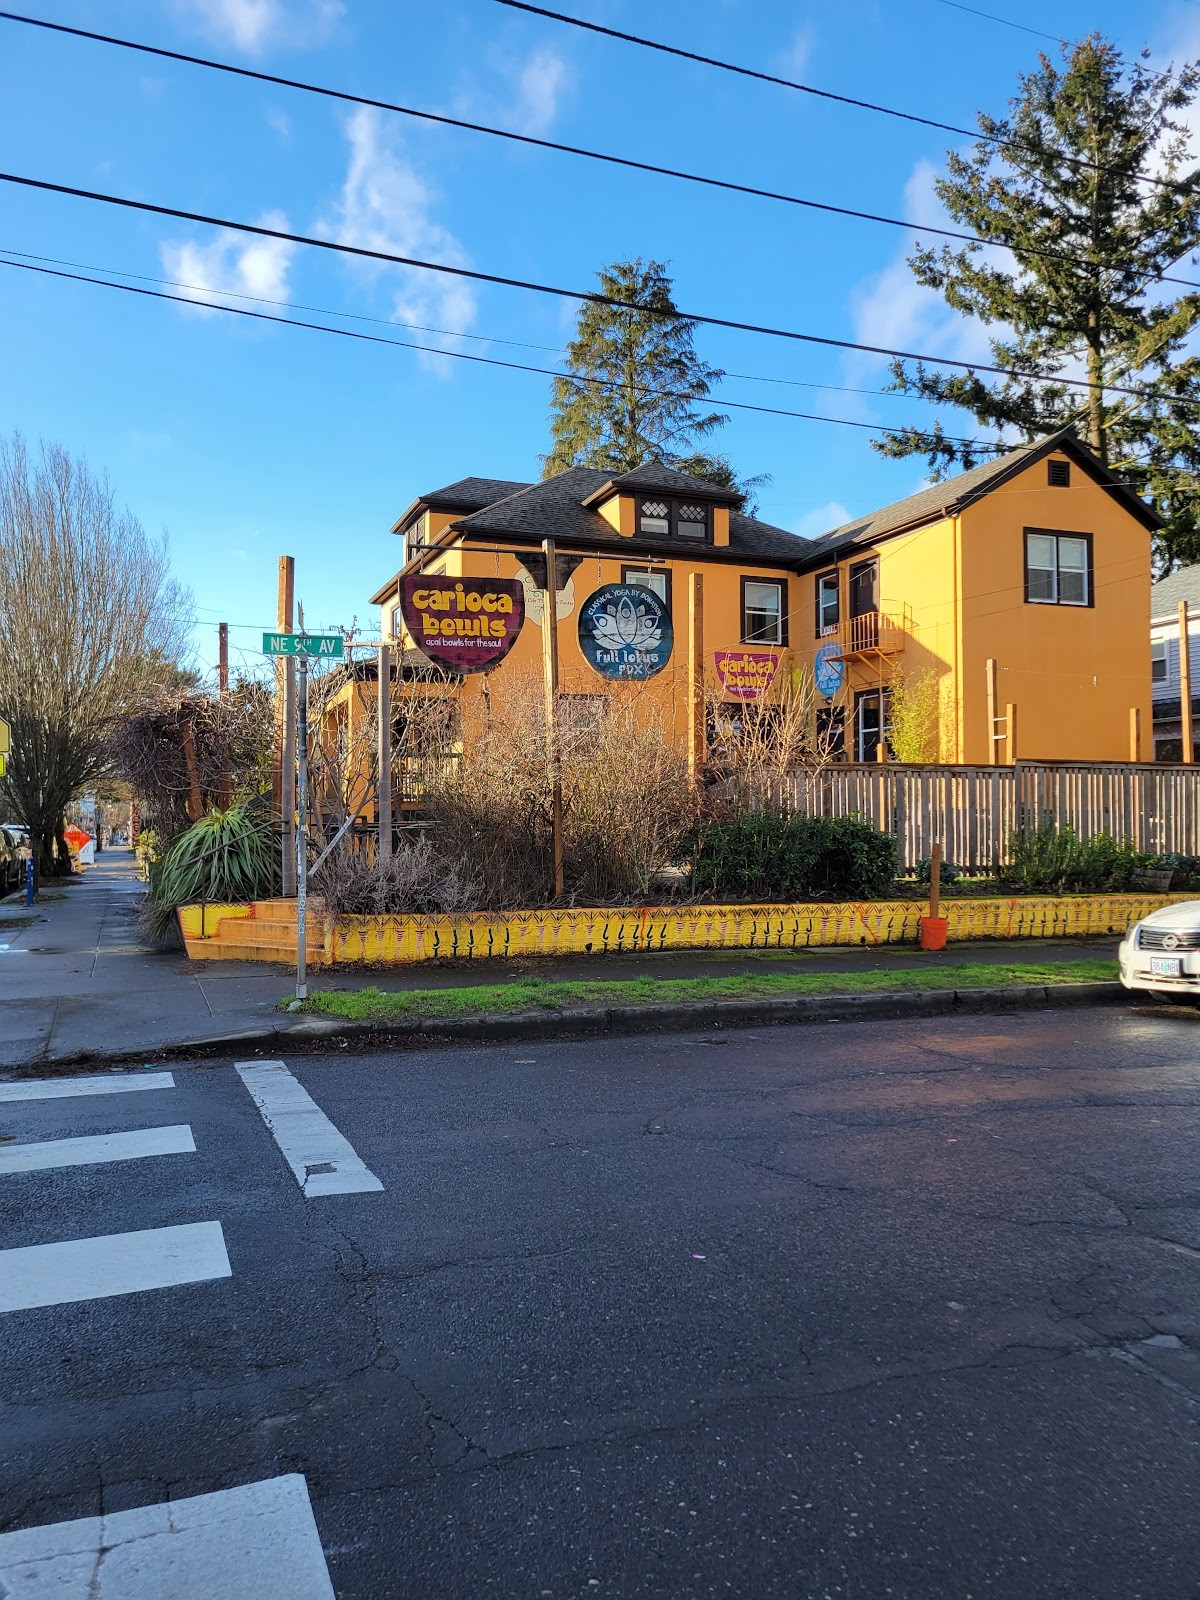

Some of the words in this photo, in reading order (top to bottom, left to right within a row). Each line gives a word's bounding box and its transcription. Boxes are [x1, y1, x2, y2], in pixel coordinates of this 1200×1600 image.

[412, 582, 513, 614] carioca
[587, 592, 614, 616] CLASSICAL
[612, 589, 630, 597] YOGA
[631, 589, 640, 597] BY
[640, 592, 663, 617] DONATION
[421, 613, 507, 637] bowls
[270, 636, 289, 652] NE
[319, 639, 336, 654] AV
[442, 637, 465, 647] bowls
[464, 637, 476, 647] for
[622, 649, 659, 664] lotus
[719, 654, 775, 674] carioca
[618, 664, 643, 675] PDX
[727, 673, 767, 688] bowls
